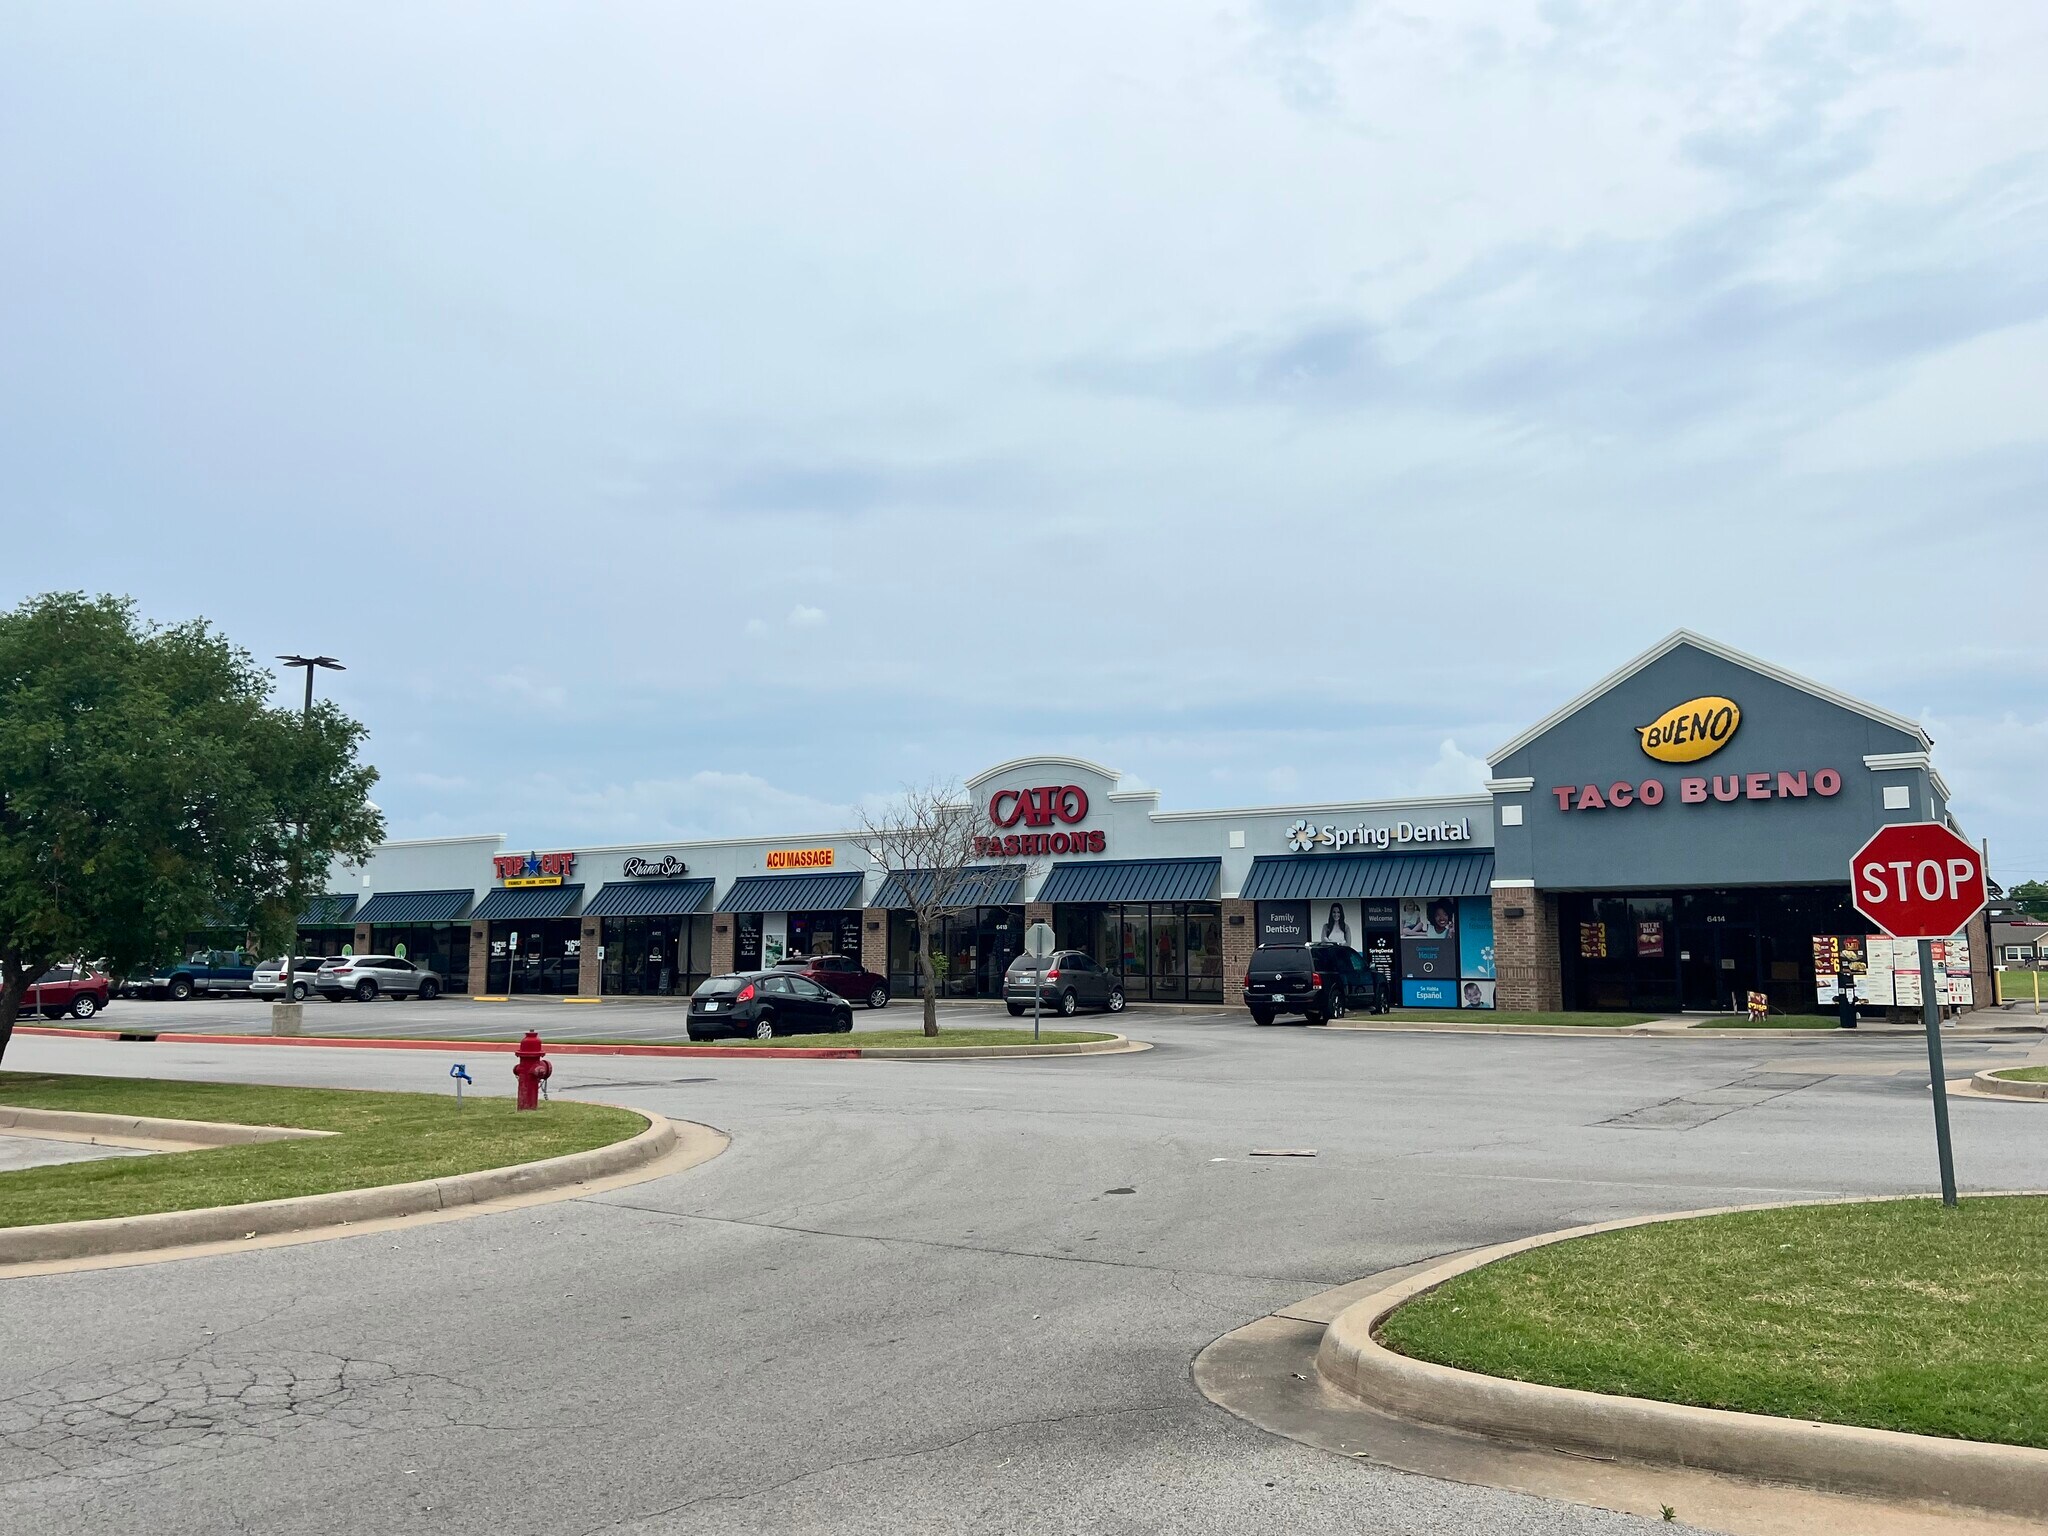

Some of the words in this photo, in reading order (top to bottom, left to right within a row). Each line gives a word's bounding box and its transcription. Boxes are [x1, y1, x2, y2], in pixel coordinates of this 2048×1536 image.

[1646, 706, 1733, 748] BUENO
[1552, 778, 1665, 812] TACO
[1680, 767, 1843, 804] BUENO
[989, 784, 1090, 828] CATO
[974, 830, 1107, 857] FASHIONS
[1321, 822, 1392, 850] Spring
[1397, 817, 1471, 844] Dental
[493, 856, 524, 879] TOP
[541, 852, 575, 877] CUT
[661, 856, 684, 877] Spa
[767, 852, 786, 867] ACU
[787, 850, 832, 867] MASSAGE
[1862, 858, 1975, 904] STOP
[1265, 925, 1300, 934] Dentistry
[1270, 913, 1294, 923] Family
[1830, 937, 1839, 952] 3
[1830, 958, 1840, 972] $6
[1416, 992, 1442, 1000] Español
